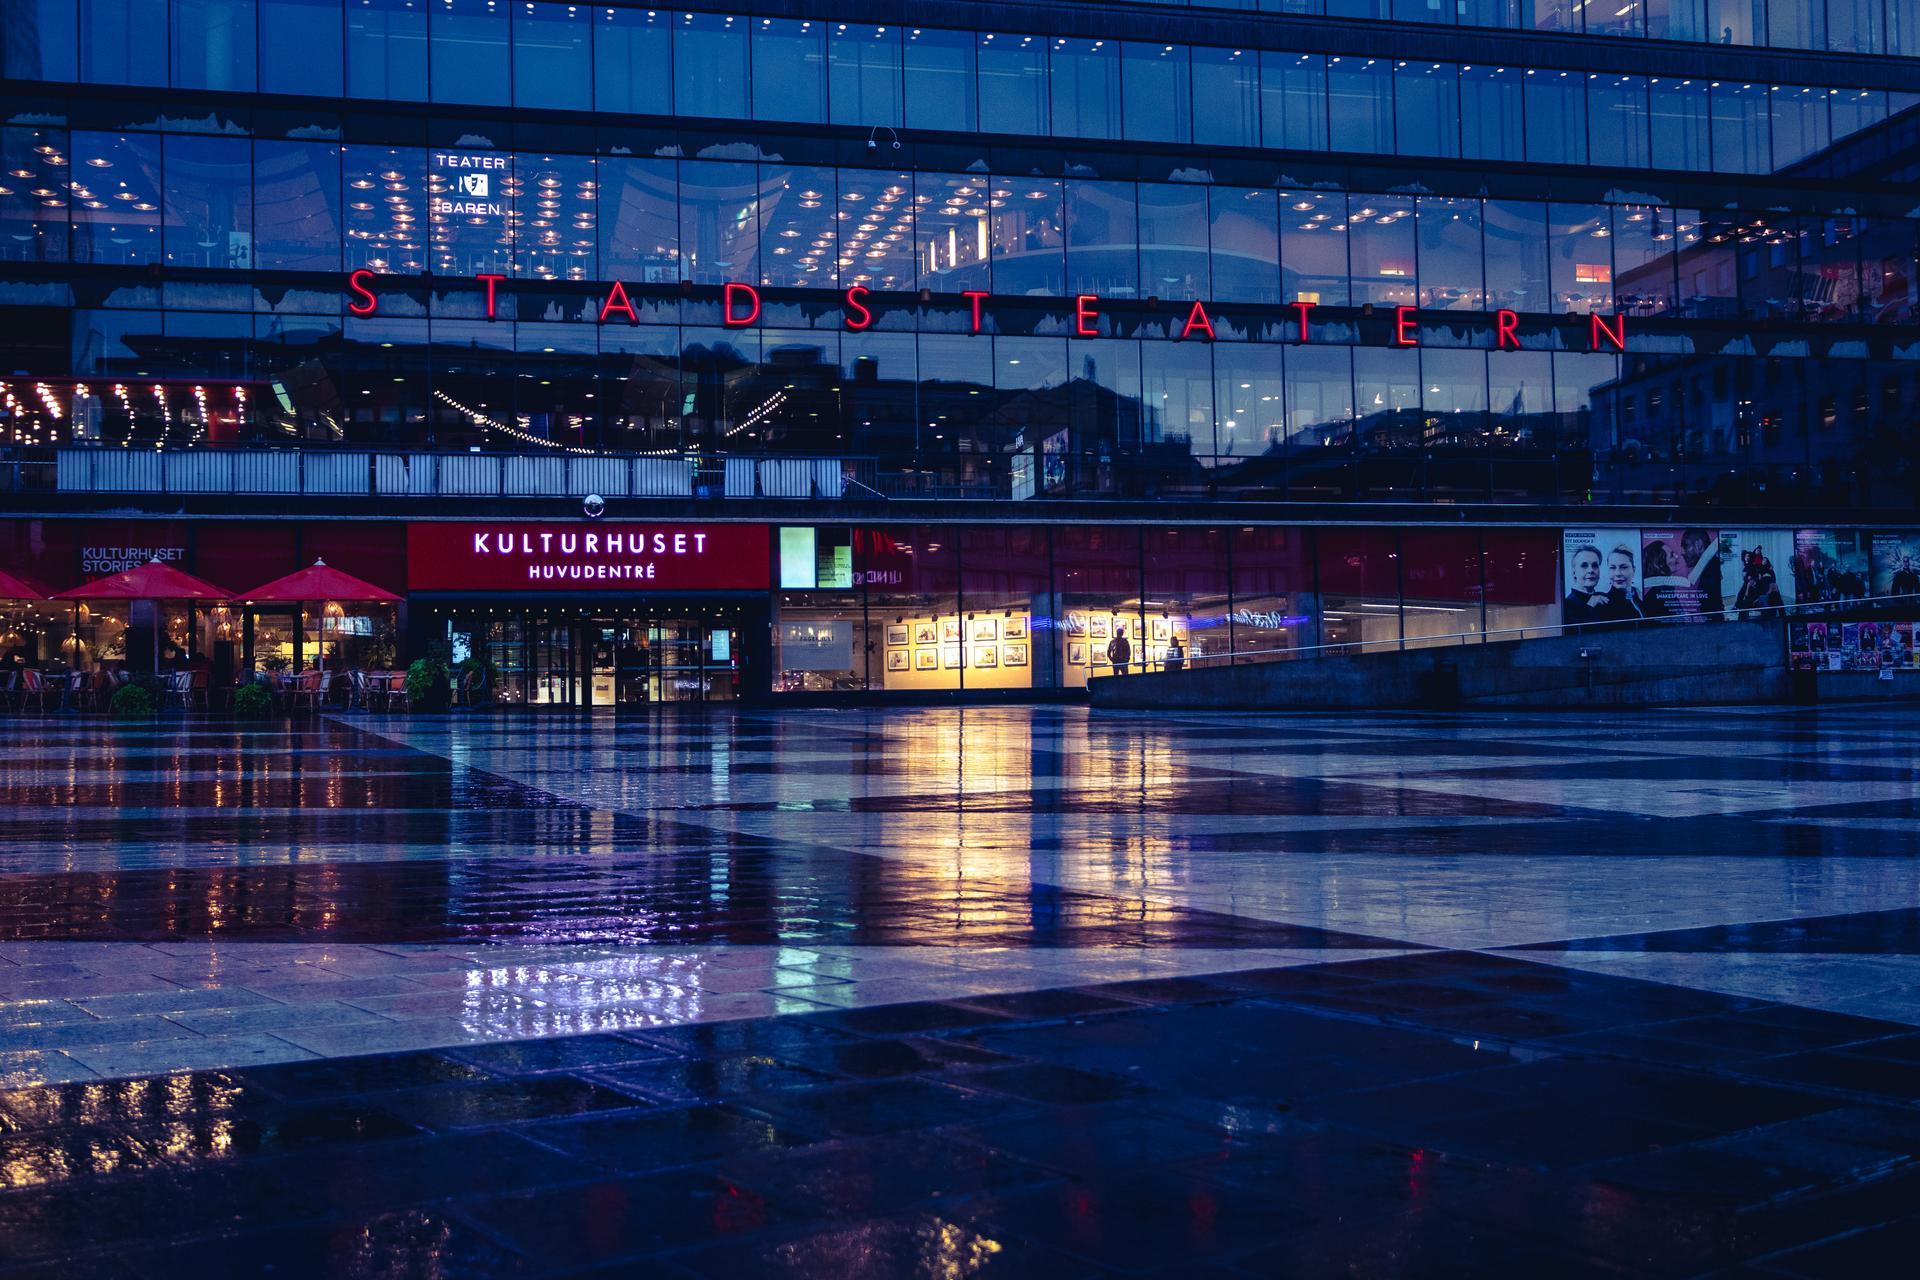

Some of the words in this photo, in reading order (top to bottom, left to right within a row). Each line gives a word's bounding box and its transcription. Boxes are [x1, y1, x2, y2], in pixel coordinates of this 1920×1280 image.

[436, 154, 505, 169] TEATER
[441, 202, 500, 216] BAREN
[348, 269, 1625, 352] STADSTEATERN
[474, 533, 707, 554] KULTURHUSET
[82, 547, 185, 560] KULTURHUSET
[529, 562, 656, 579] HUVUDENTRÉ
